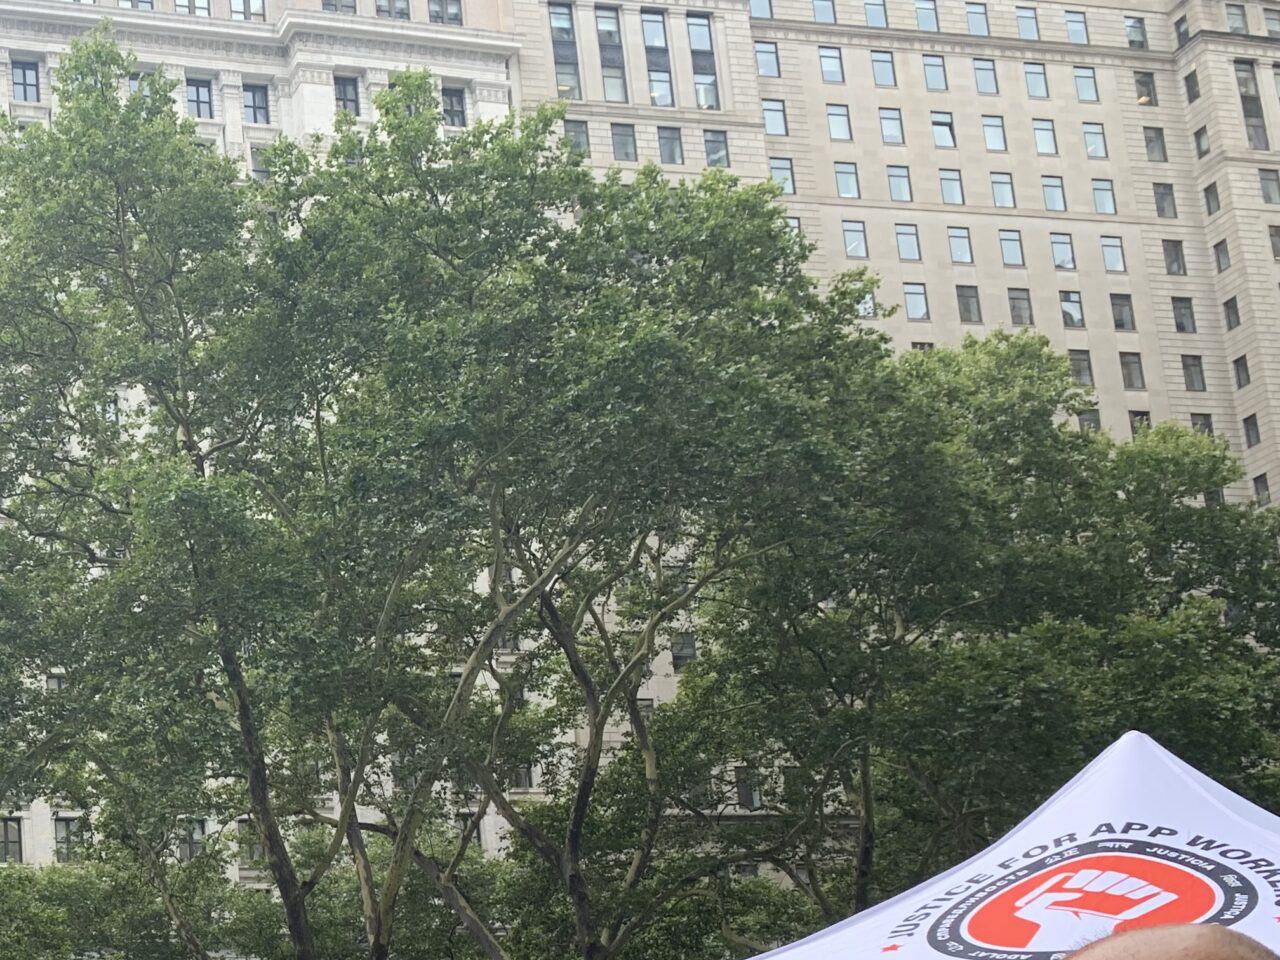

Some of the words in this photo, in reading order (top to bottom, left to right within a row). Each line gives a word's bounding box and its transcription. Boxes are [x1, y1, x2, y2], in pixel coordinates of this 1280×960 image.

[888, 872, 995, 938] JUSTICE
[997, 832, 1078, 870] FOR
[1089, 821, 1179, 838] APP
